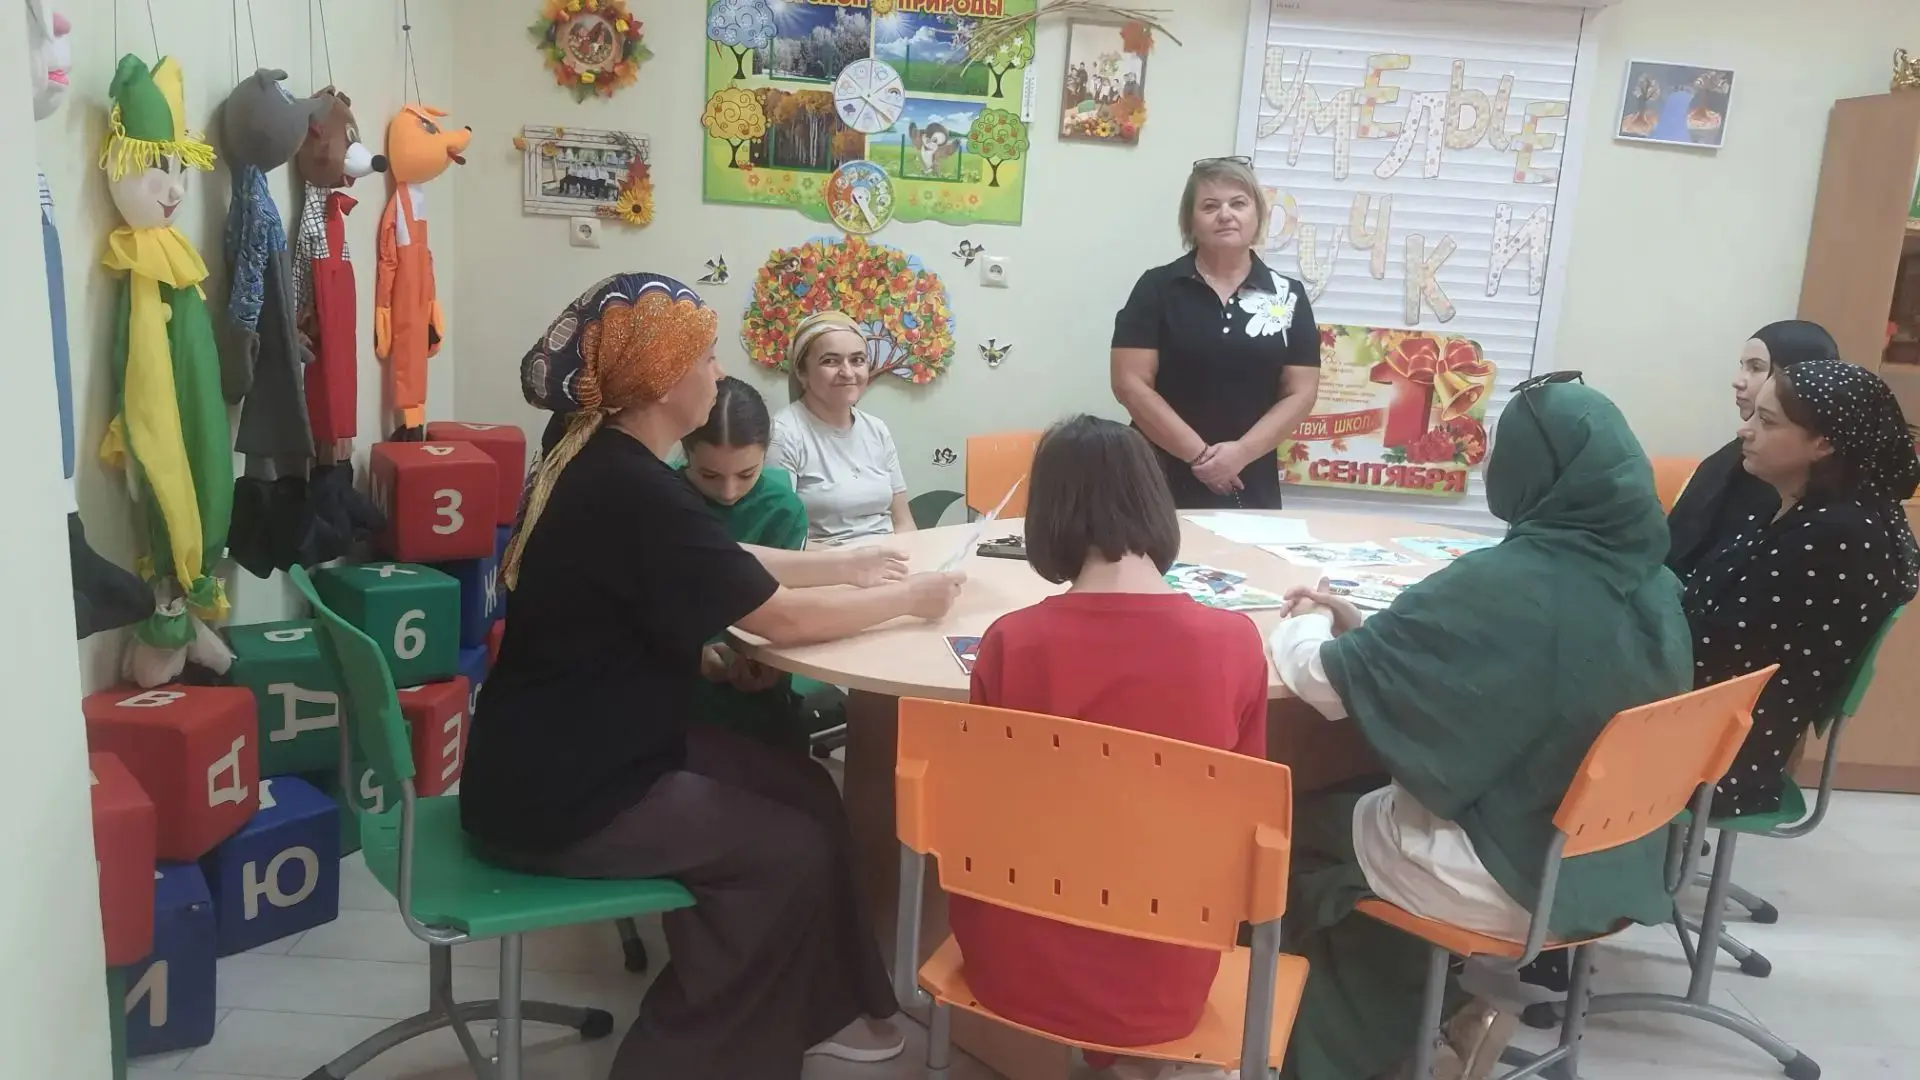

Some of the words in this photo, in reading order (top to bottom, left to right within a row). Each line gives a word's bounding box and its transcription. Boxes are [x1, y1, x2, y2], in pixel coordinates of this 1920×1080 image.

[1308, 458, 1467, 493] СЕНТЯБРЯ
[394, 609, 426, 660] 6
[268, 683, 339, 742] Д
[207, 735, 249, 808] Д
[243, 846, 319, 920] Ю
